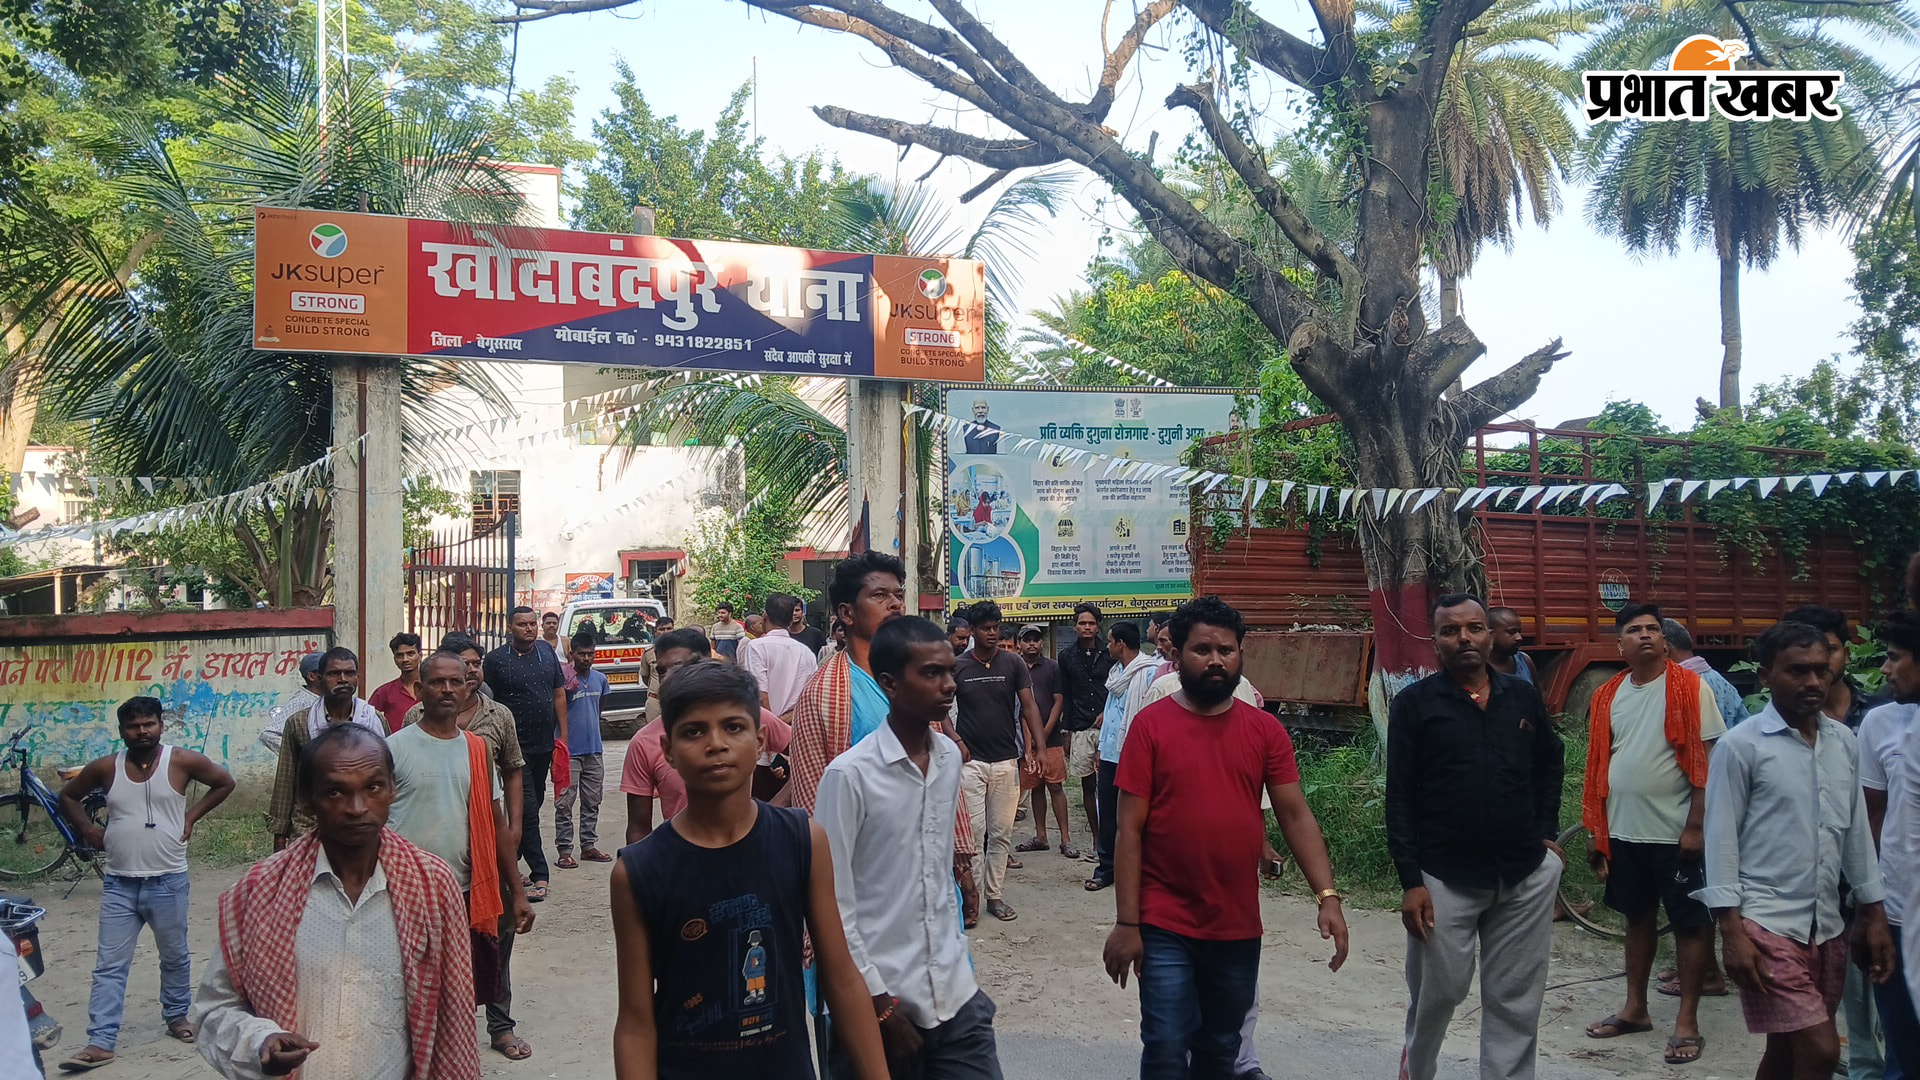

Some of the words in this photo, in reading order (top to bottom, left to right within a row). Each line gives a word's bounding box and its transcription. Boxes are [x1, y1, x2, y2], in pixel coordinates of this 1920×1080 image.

[298, 295, 359, 310] STRONG
[285, 315, 332, 325] CONCRETE
[335, 318, 371, 327] SPECIAL
[285, 324, 319, 335] BUILD
[322, 326, 370, 337] STRONG
[909, 331, 955, 344] STRONG
[431, 331, 462, 348] जिला
[476, 333, 523, 354] बेगूसराय
[554, 326, 611, 345] मोबाईल
[655, 334, 752, 351] 9431822851
[764, 347, 784, 363] सदैव
[787, 350, 816, 364] आपकी
[818, 352, 841, 368] सुरक्षा
[844, 351, 853, 366] में
[938, 349, 965, 358] SPECIAL
[900, 357, 927, 365] BUILD
[929, 359, 965, 367] STRONG
[1039, 423, 1057, 439] प्रति
[1059, 423, 1084, 440] व्यक्ति
[1086, 426, 1112, 445] दुगुना
[1114, 424, 1150, 440] रोजगार
[1158, 424, 1184, 445] दुगुनी
[1015, 600, 1029, 611] एवं
[1032, 601, 1051, 610] जन
[1130, 597, 1168, 610] बेगूसराय
[0, 650, 33, 686] ाने
[36, 659, 65, 684] पर
[72, 646, 153, 691] 101/112
[201, 652, 274, 680] डायल
